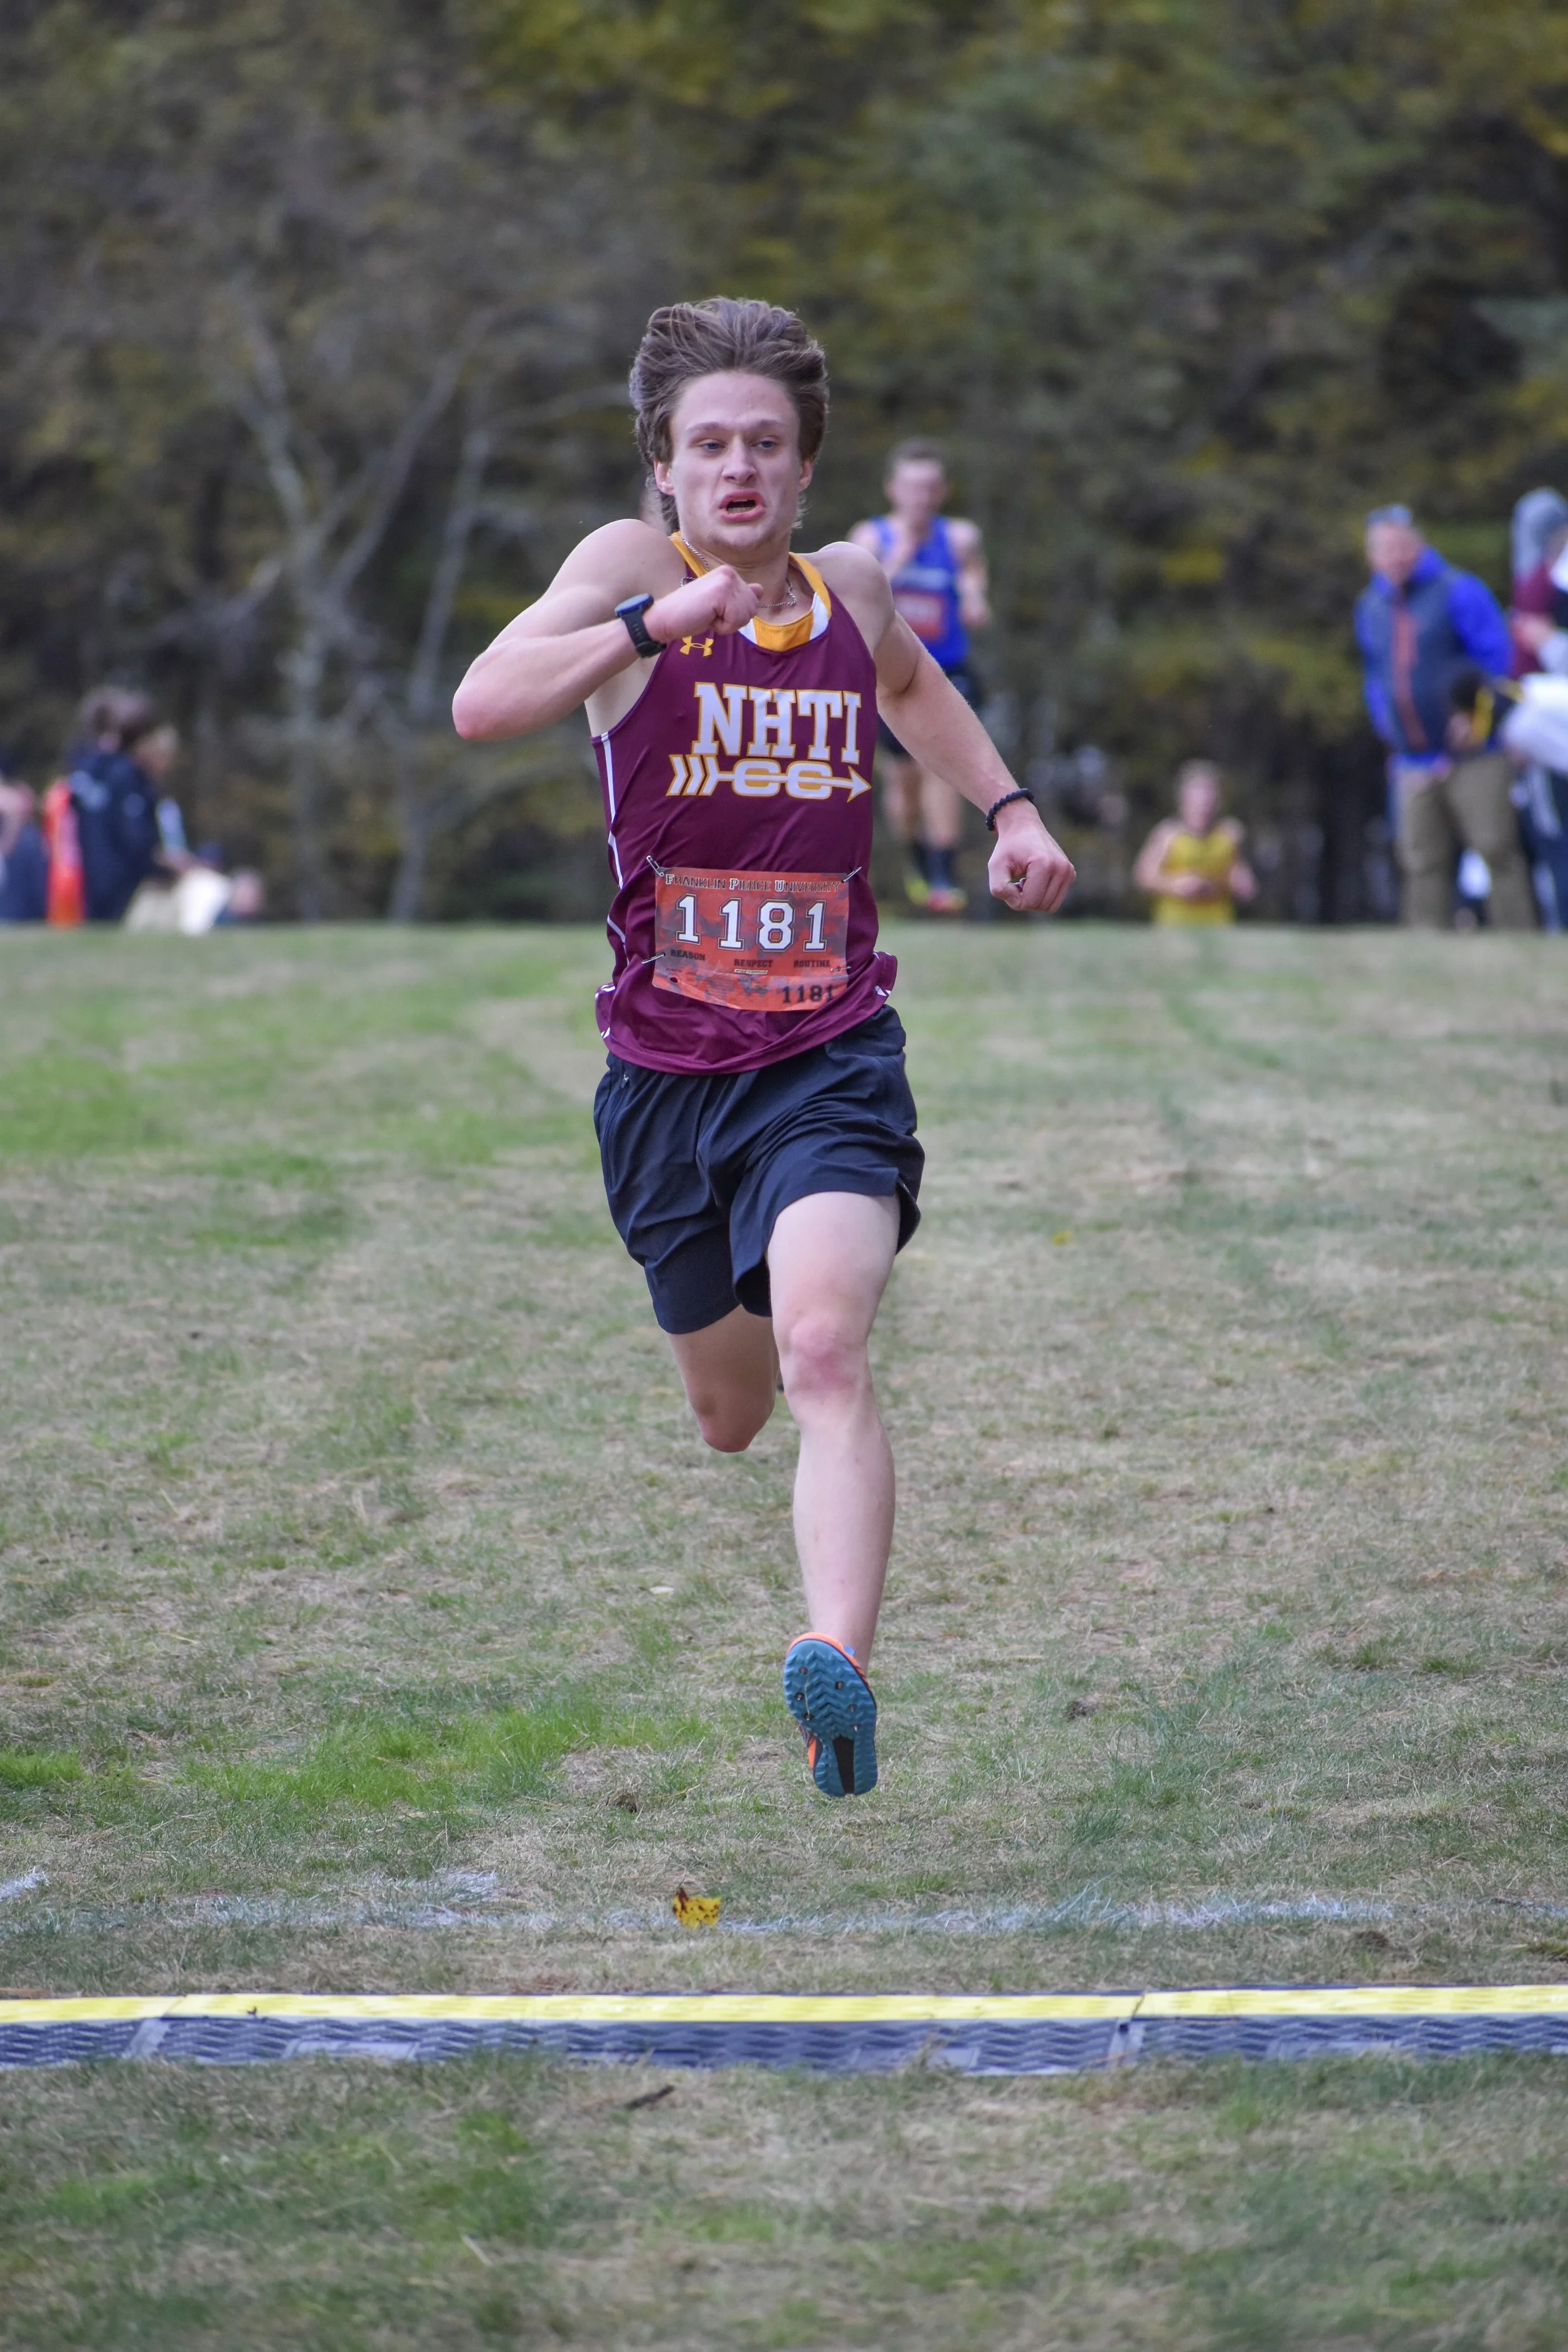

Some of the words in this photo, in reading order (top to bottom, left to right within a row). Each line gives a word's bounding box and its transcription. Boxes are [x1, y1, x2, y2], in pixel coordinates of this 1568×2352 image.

[692, 682, 861, 765] NHTI
[665, 874, 726, 889] FRANKLIN
[729, 878, 771, 892] PIERCE
[775, 880, 840, 893] UNIVERSITY
[675, 893, 827, 951] 1181
[670, 949, 706, 961] REASON
[734, 958, 773, 968] RESPECT
[793, 960, 831, 968] ROUTINE
[783, 984, 834, 1004] 1181
